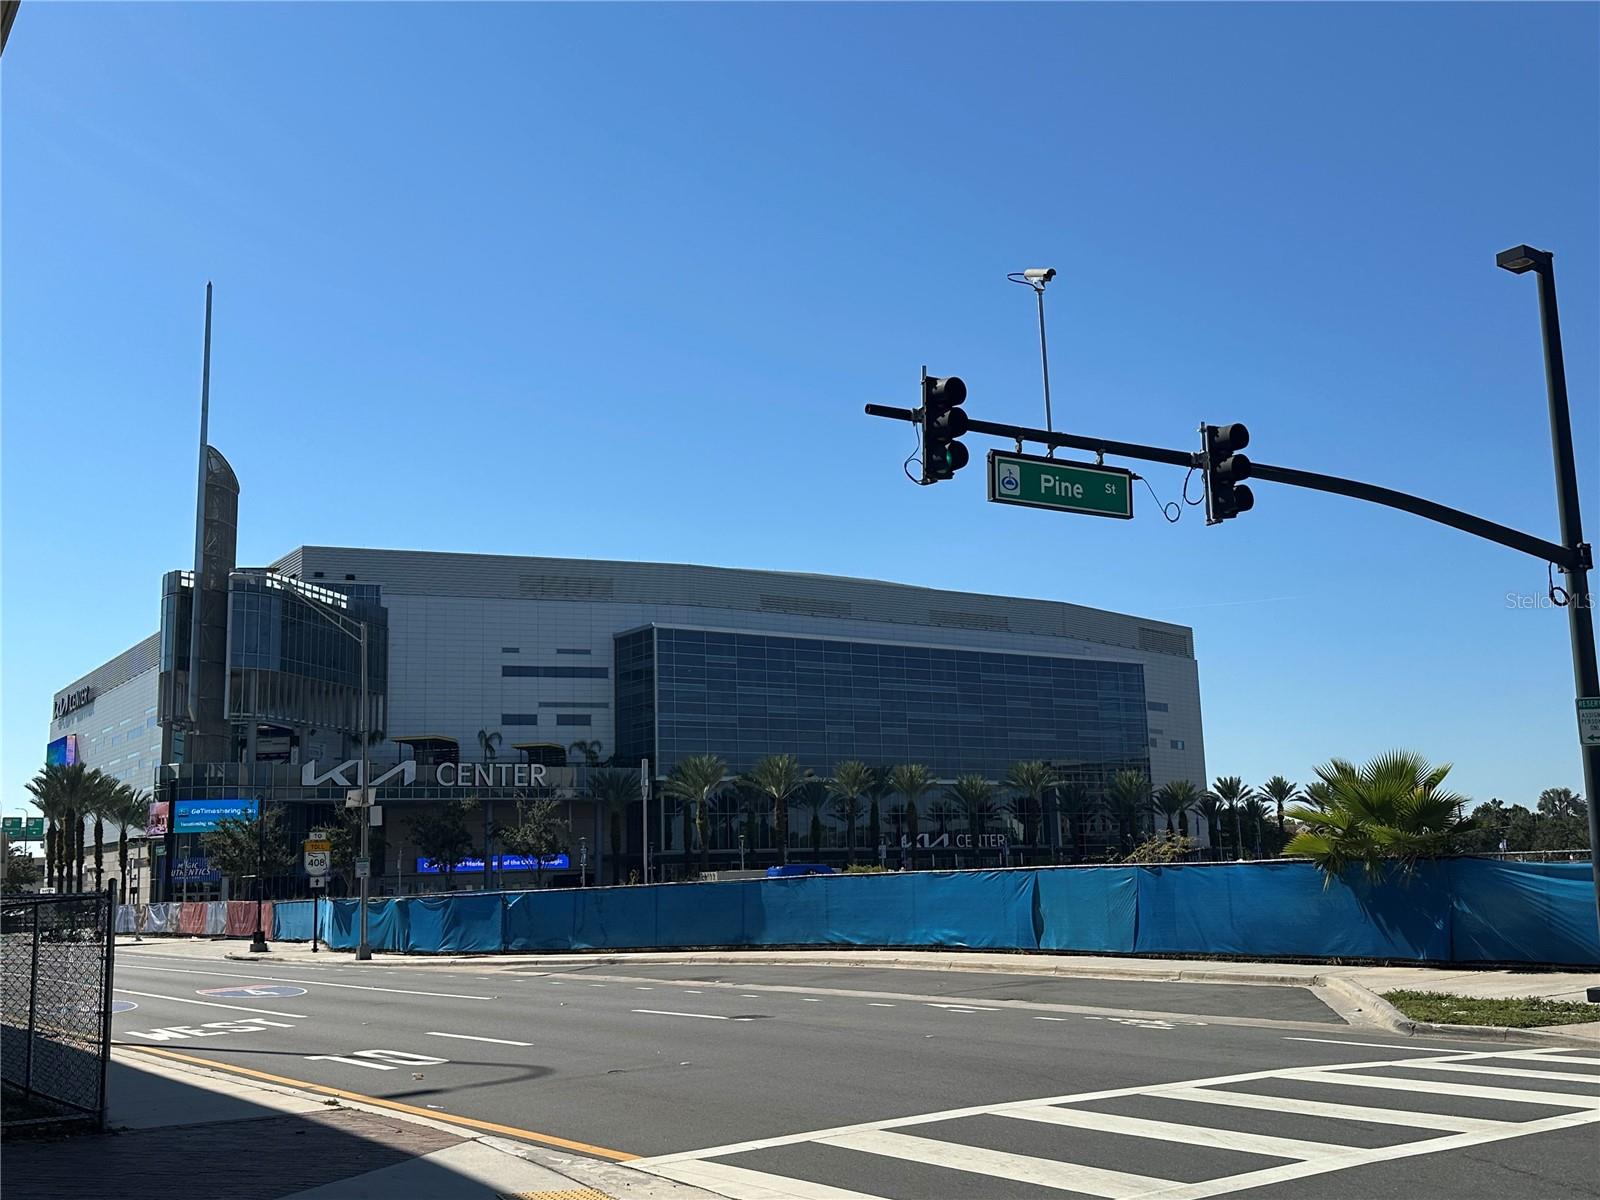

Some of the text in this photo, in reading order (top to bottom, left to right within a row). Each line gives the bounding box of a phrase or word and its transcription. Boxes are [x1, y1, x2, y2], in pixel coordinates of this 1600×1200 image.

[1040, 474, 1117, 499] Pine St
[301, 760, 548, 787] KIA CENTER
[171, 868, 210, 877] UTHENTICS
[177, 862, 198, 870] MGIC
[308, 858, 325, 867] 408
[123, 1018, 295, 1041] WEST
[303, 1049, 450, 1071] TO
